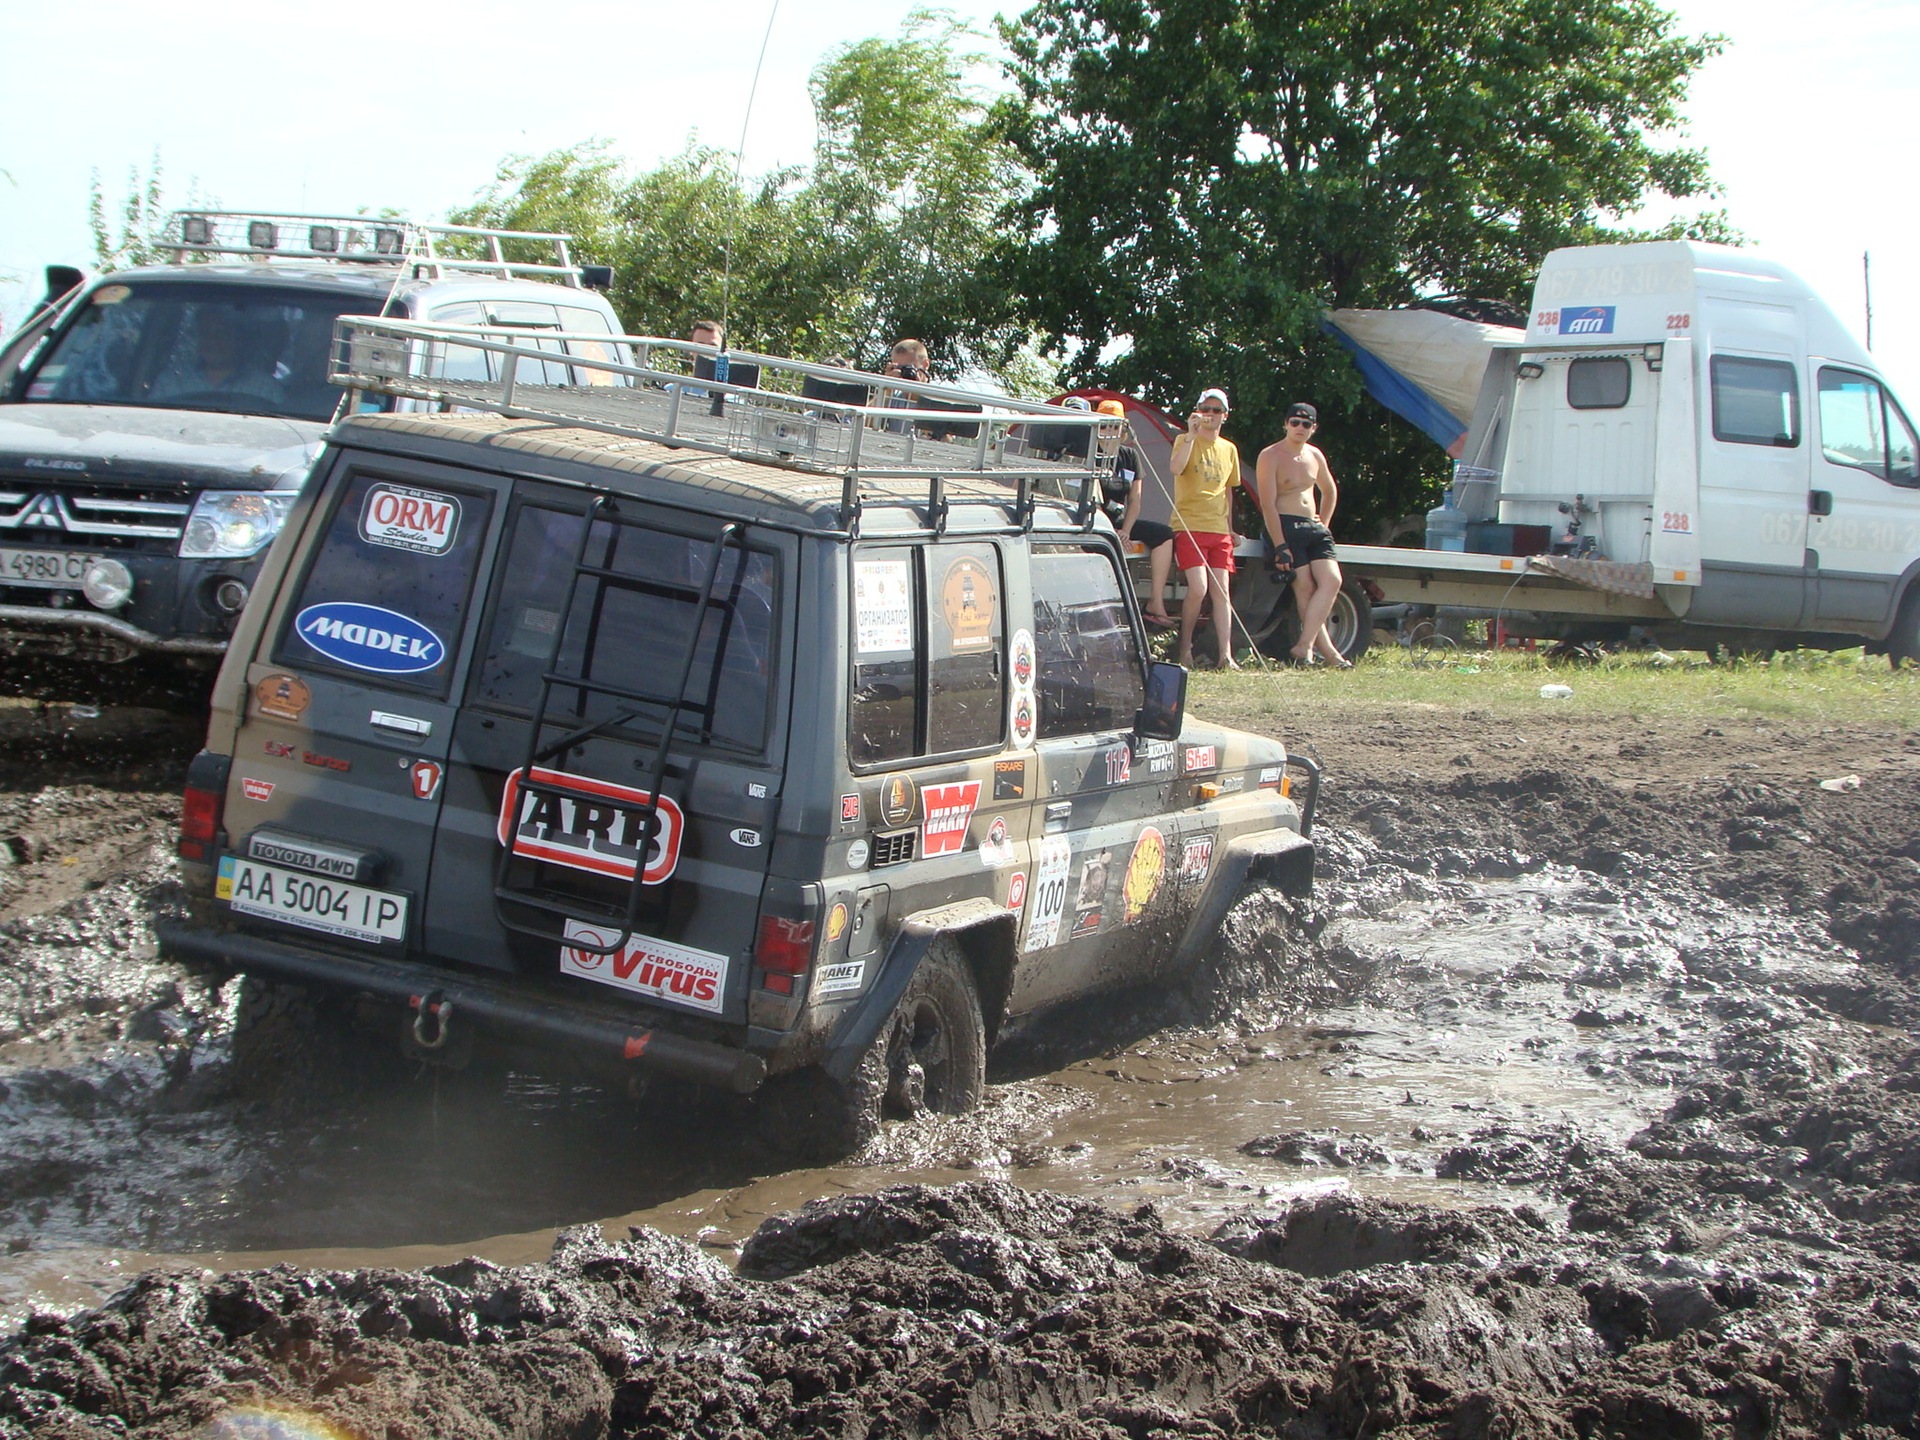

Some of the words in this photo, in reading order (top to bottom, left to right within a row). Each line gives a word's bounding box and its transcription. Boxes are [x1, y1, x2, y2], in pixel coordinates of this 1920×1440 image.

[1666, 314, 1690, 330] 228
[24, 458, 88, 471] PAJERO
[374, 495, 451, 535] ORM
[1663, 511, 1690, 530] 238
[383, 527, 427, 542] Studio
[11, 554, 60, 577] 4980
[858, 609, 908, 627] ОРГАНИЗАТОР
[304, 617, 435, 660] MADEK
[995, 761, 1023, 772] FISKARS
[1105, 746, 1131, 784] 112
[1187, 747, 1215, 769] Shell
[417, 768, 431, 792] 1
[749, 783, 767, 798] VANS
[519, 789, 664, 864] ARB
[926, 804, 971, 835] WARN
[738, 829, 756, 846] VANS
[256, 843, 313, 867] TOYOTA
[317, 858, 355, 876] 4WD
[219, 884, 231, 893] UA
[235, 867, 274, 904] AA
[282, 877, 349, 921] 5004
[362, 895, 399, 929] IP
[1035, 878, 1065, 918] 100
[611, 947, 717, 1001] Virus
[647, 954, 719, 978] СВОБОДЫ
